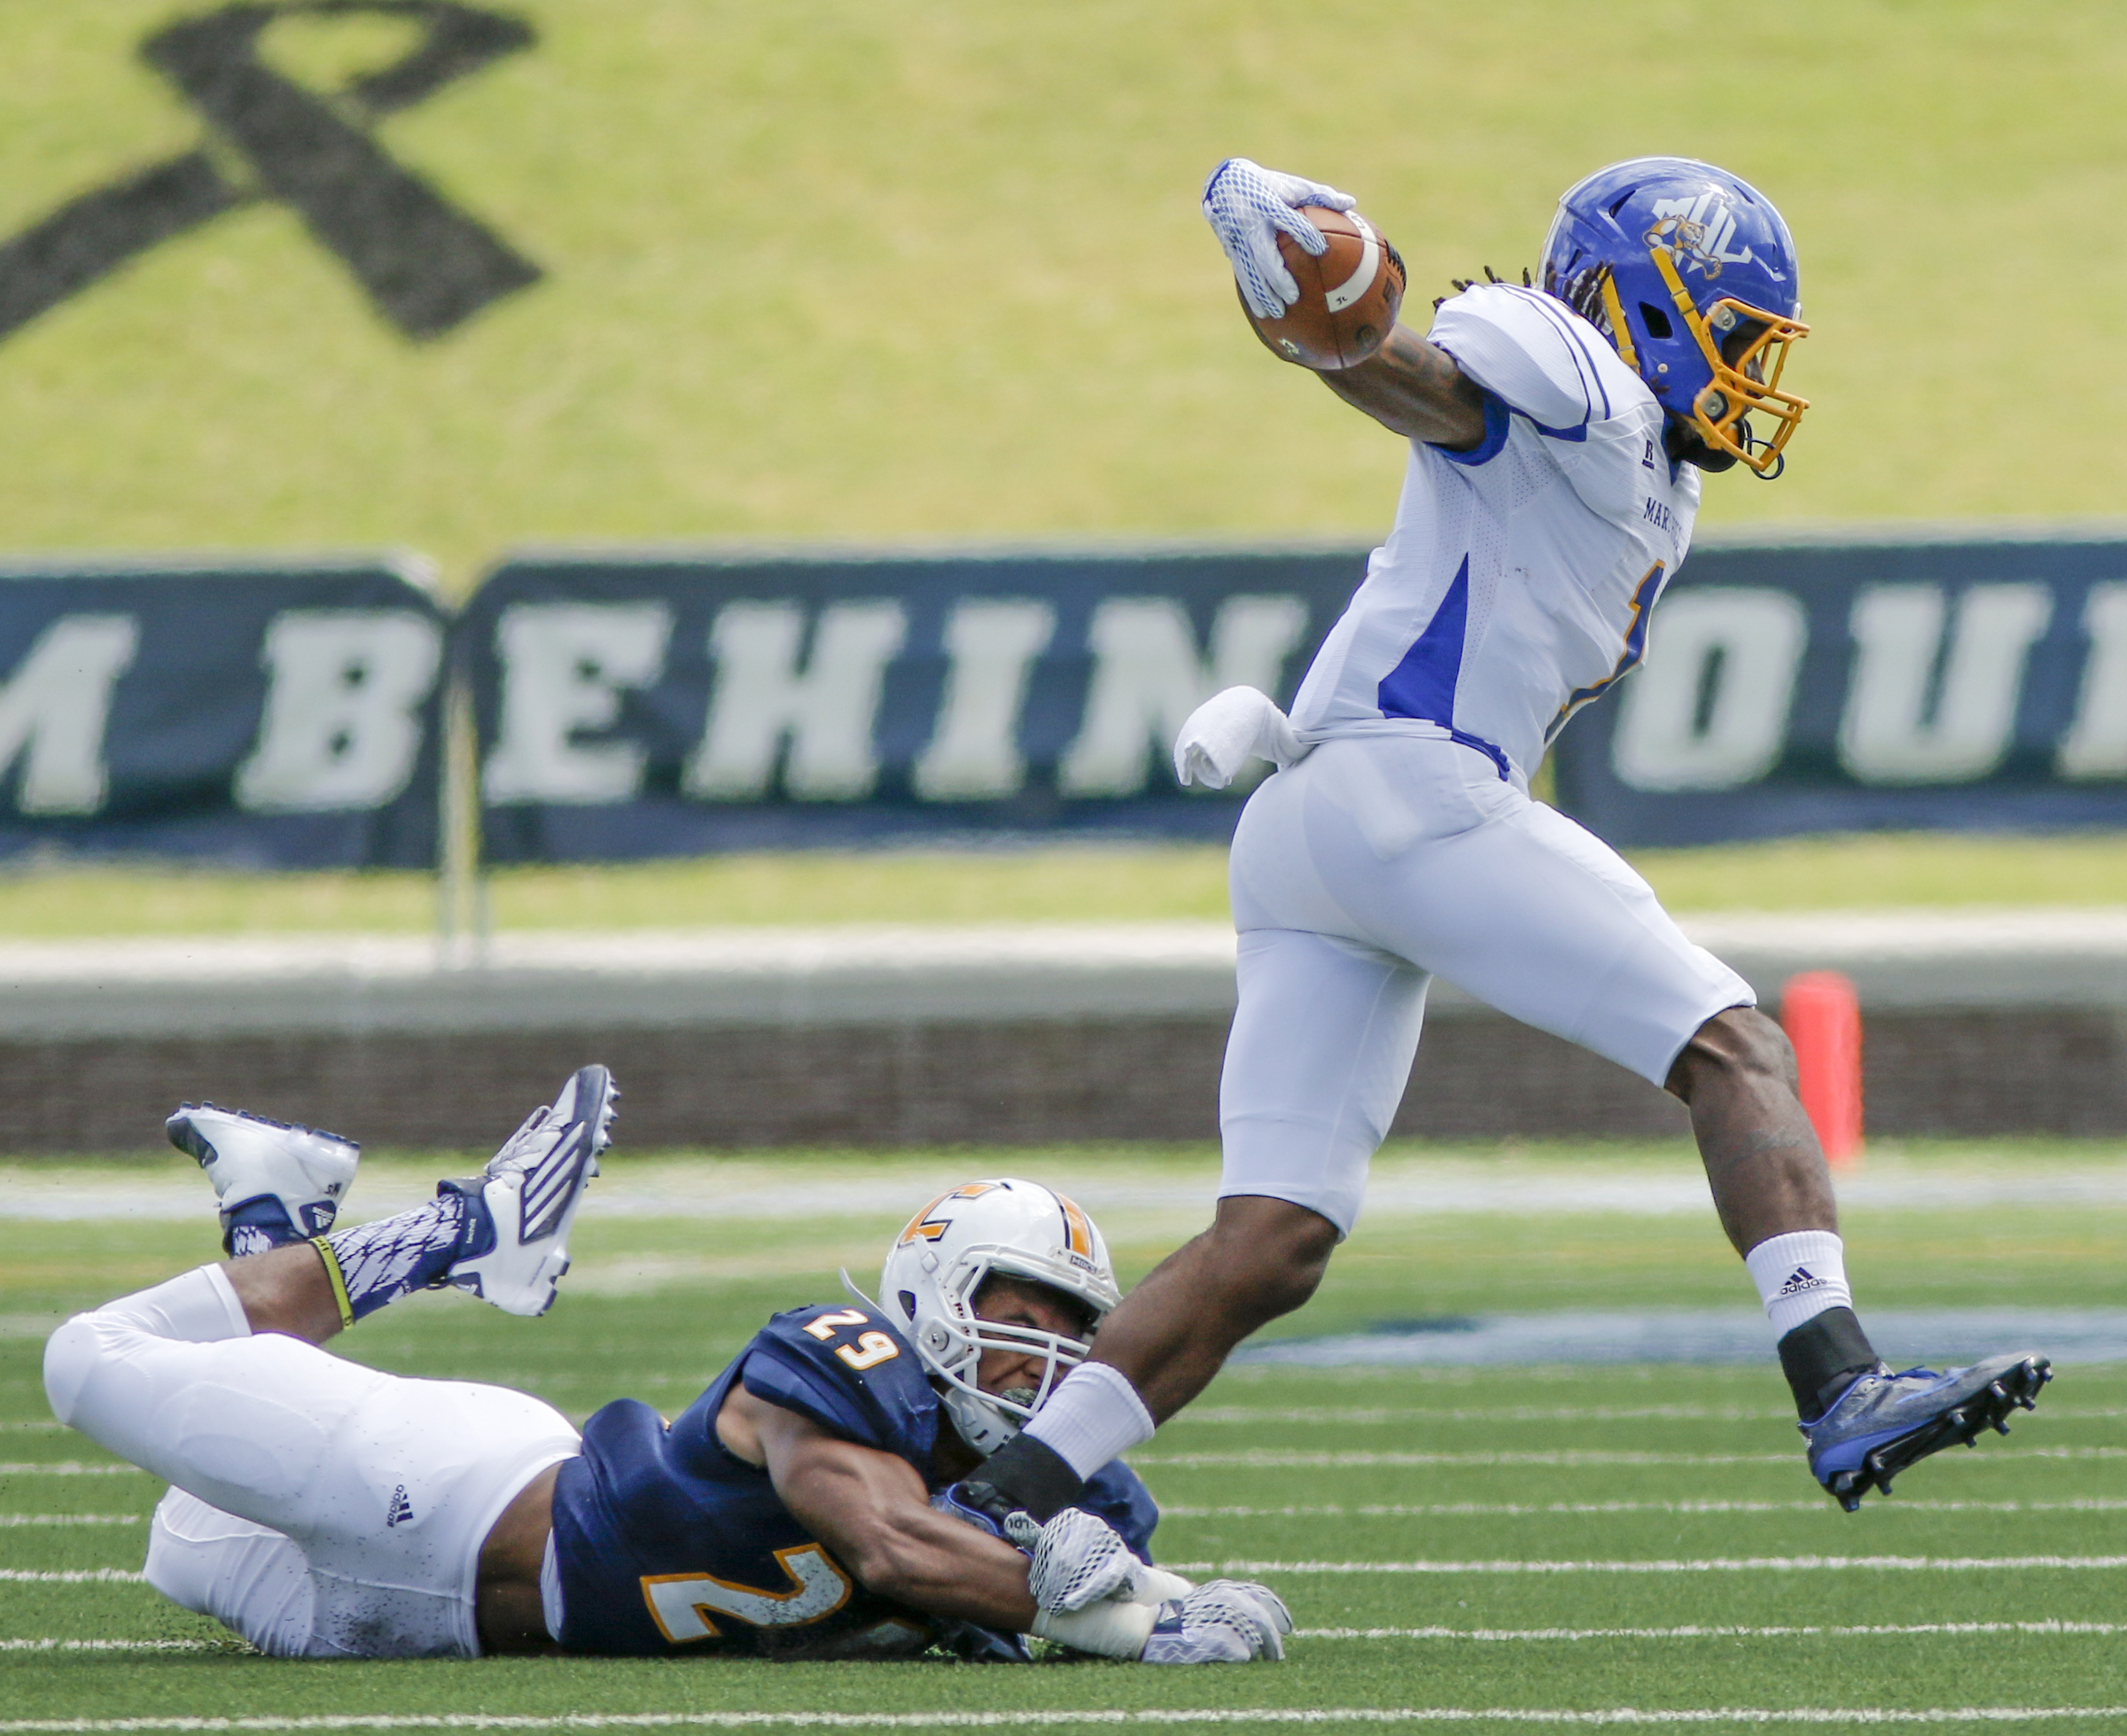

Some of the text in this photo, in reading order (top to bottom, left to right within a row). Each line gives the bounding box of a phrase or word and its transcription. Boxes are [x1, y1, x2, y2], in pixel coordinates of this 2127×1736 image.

[234, 596, 1310, 813] BEHIN
[1780, 1278, 1827, 1296] adidas
[802, 1309, 900, 1372] 29
[386, 1484, 405, 1529] adidas
[639, 1542, 929, 1648] 2
